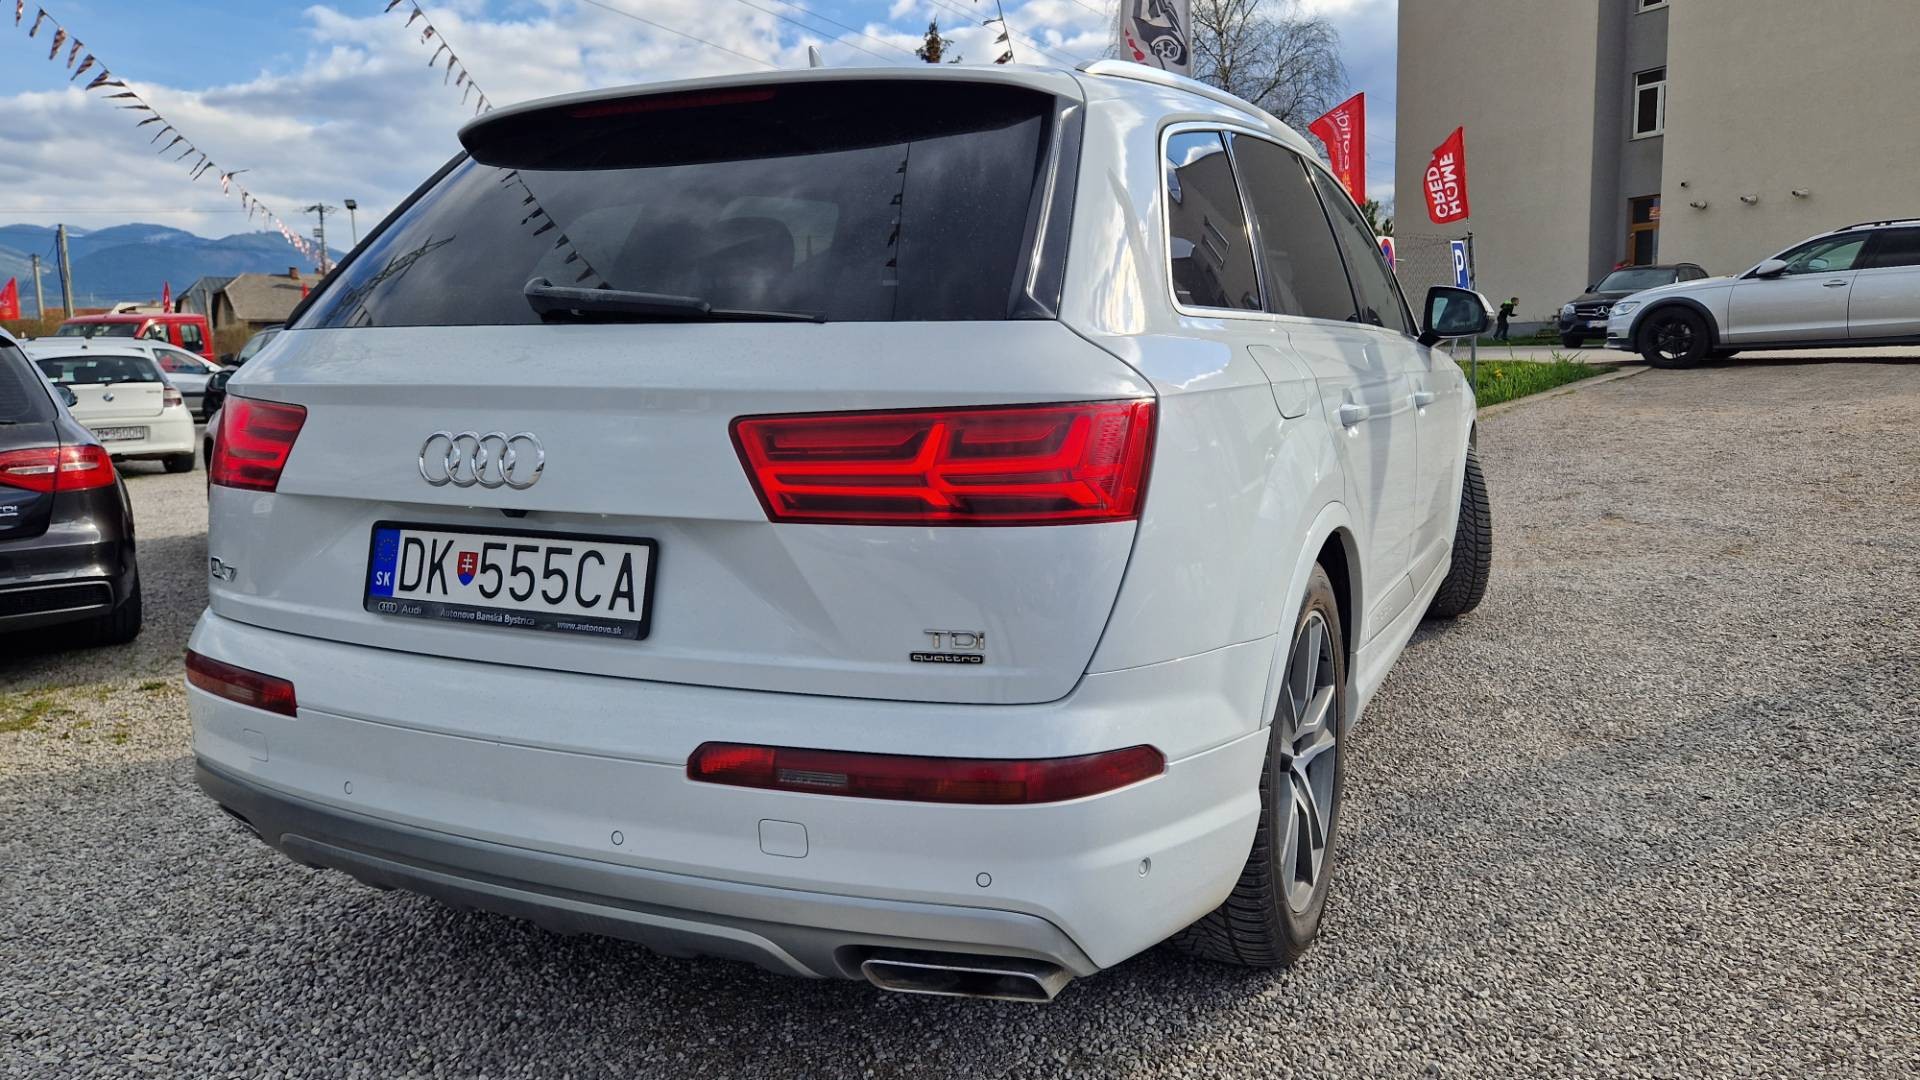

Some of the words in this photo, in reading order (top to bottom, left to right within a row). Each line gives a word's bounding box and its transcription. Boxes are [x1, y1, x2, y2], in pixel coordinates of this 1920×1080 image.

[1454, 249, 1464, 284] P
[375, 571, 391, 587] SK
[398, 536, 454, 595] DK
[478, 542, 635, 613] 555CA
[401, 604, 422, 615] Audi
[557, 621, 622, 635] www.autonovo.sk
[923, 629, 985, 650] TDI
[913, 654, 981, 663] quattro
